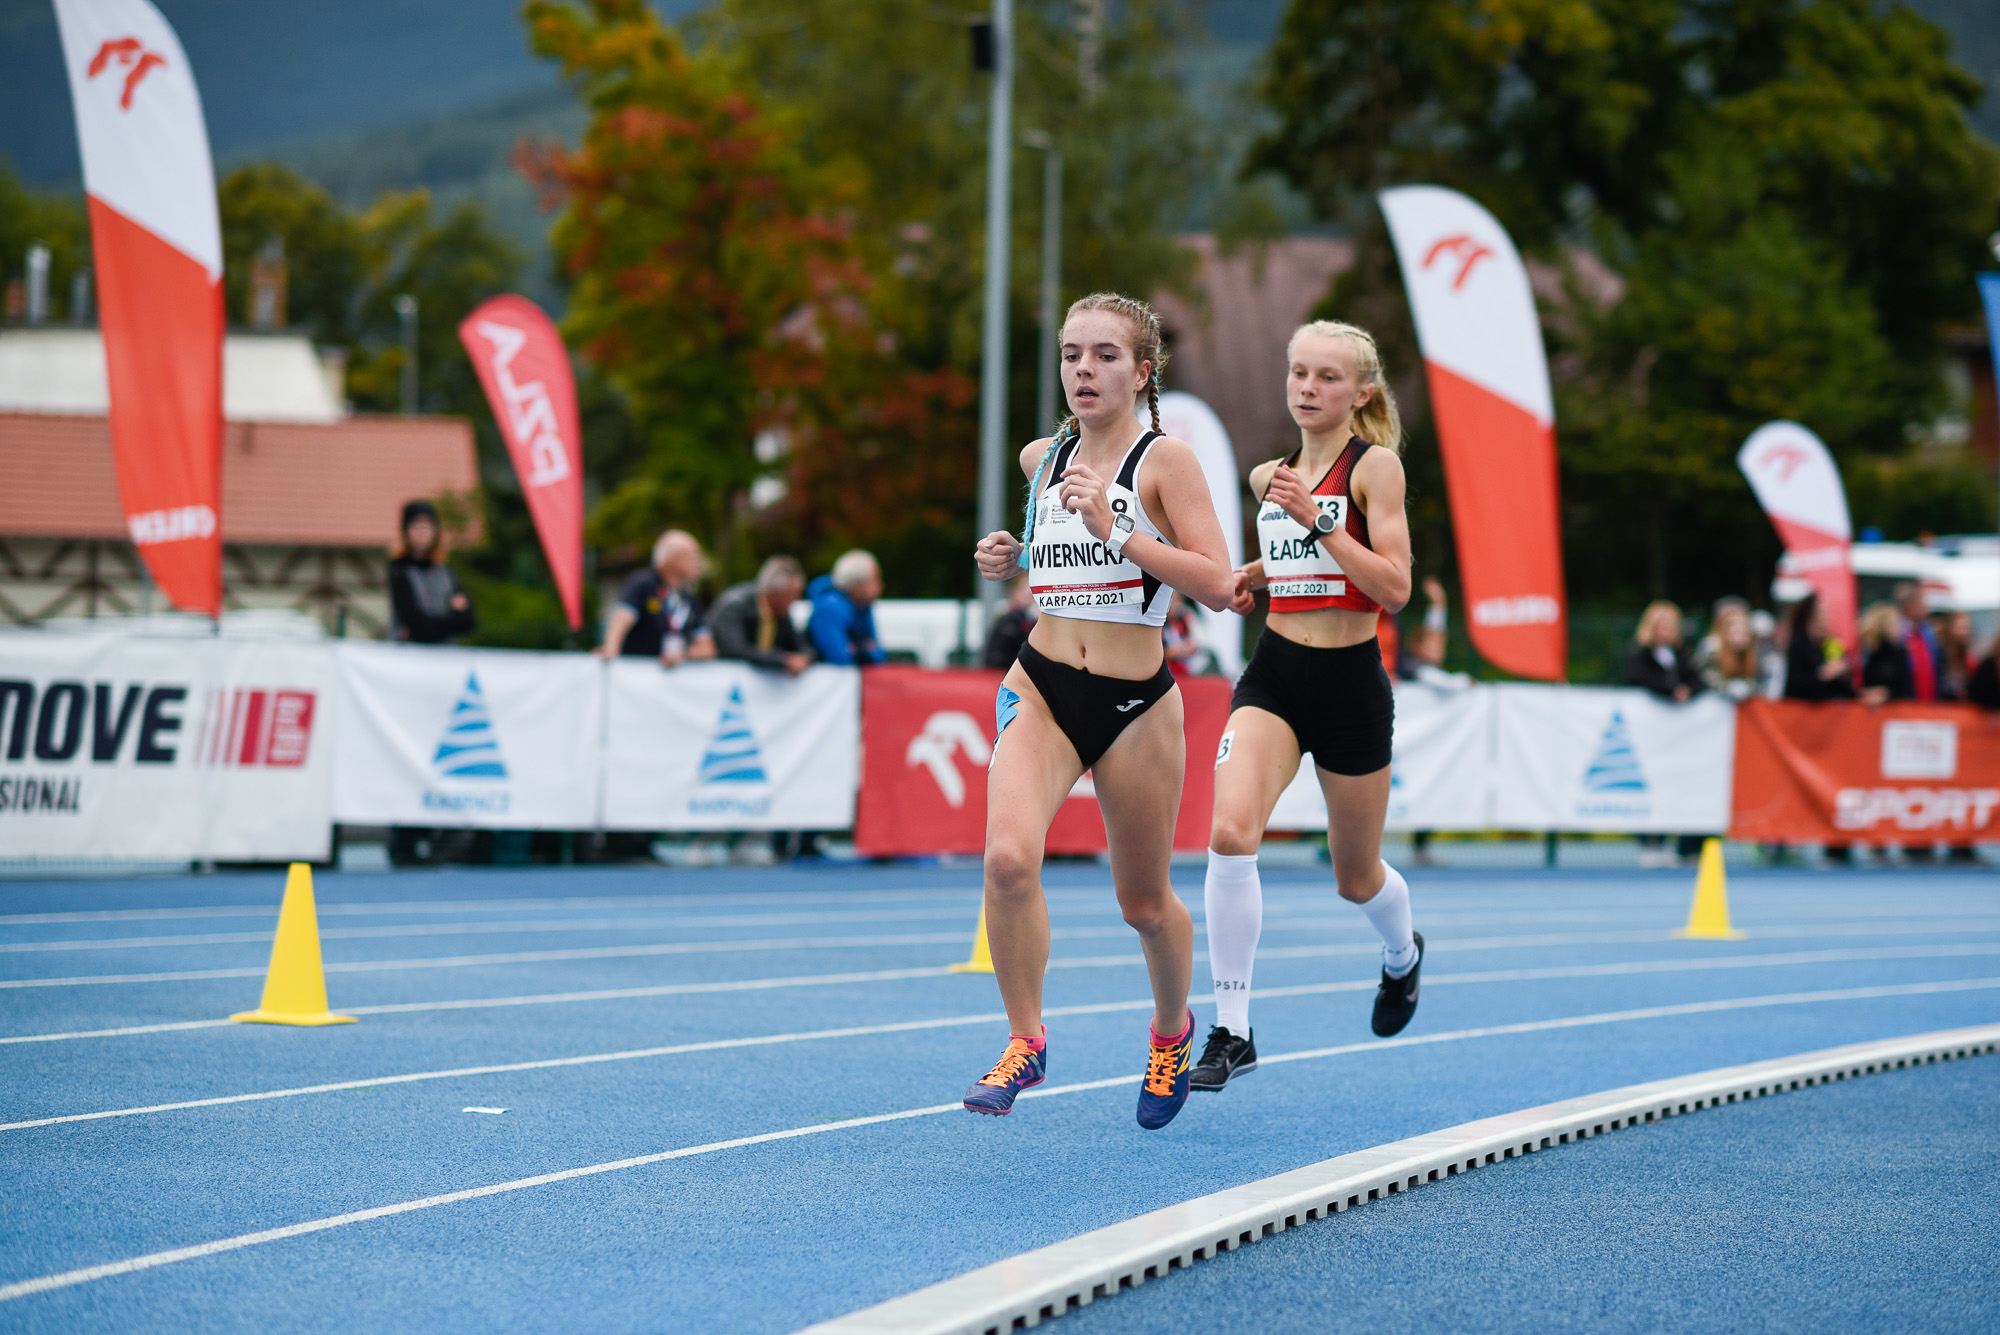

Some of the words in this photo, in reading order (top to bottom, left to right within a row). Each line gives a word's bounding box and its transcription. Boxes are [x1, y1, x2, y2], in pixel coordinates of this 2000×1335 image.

[1270, 538, 1320, 561] ŁADA
[1303, 583, 1328, 594] 2021
[1039, 594, 1092, 608] KARPACZ
[1095, 592, 1125, 605] 2021
[1834, 788, 2000, 831] SPORT
[1216, 980, 1246, 991] PSTA
